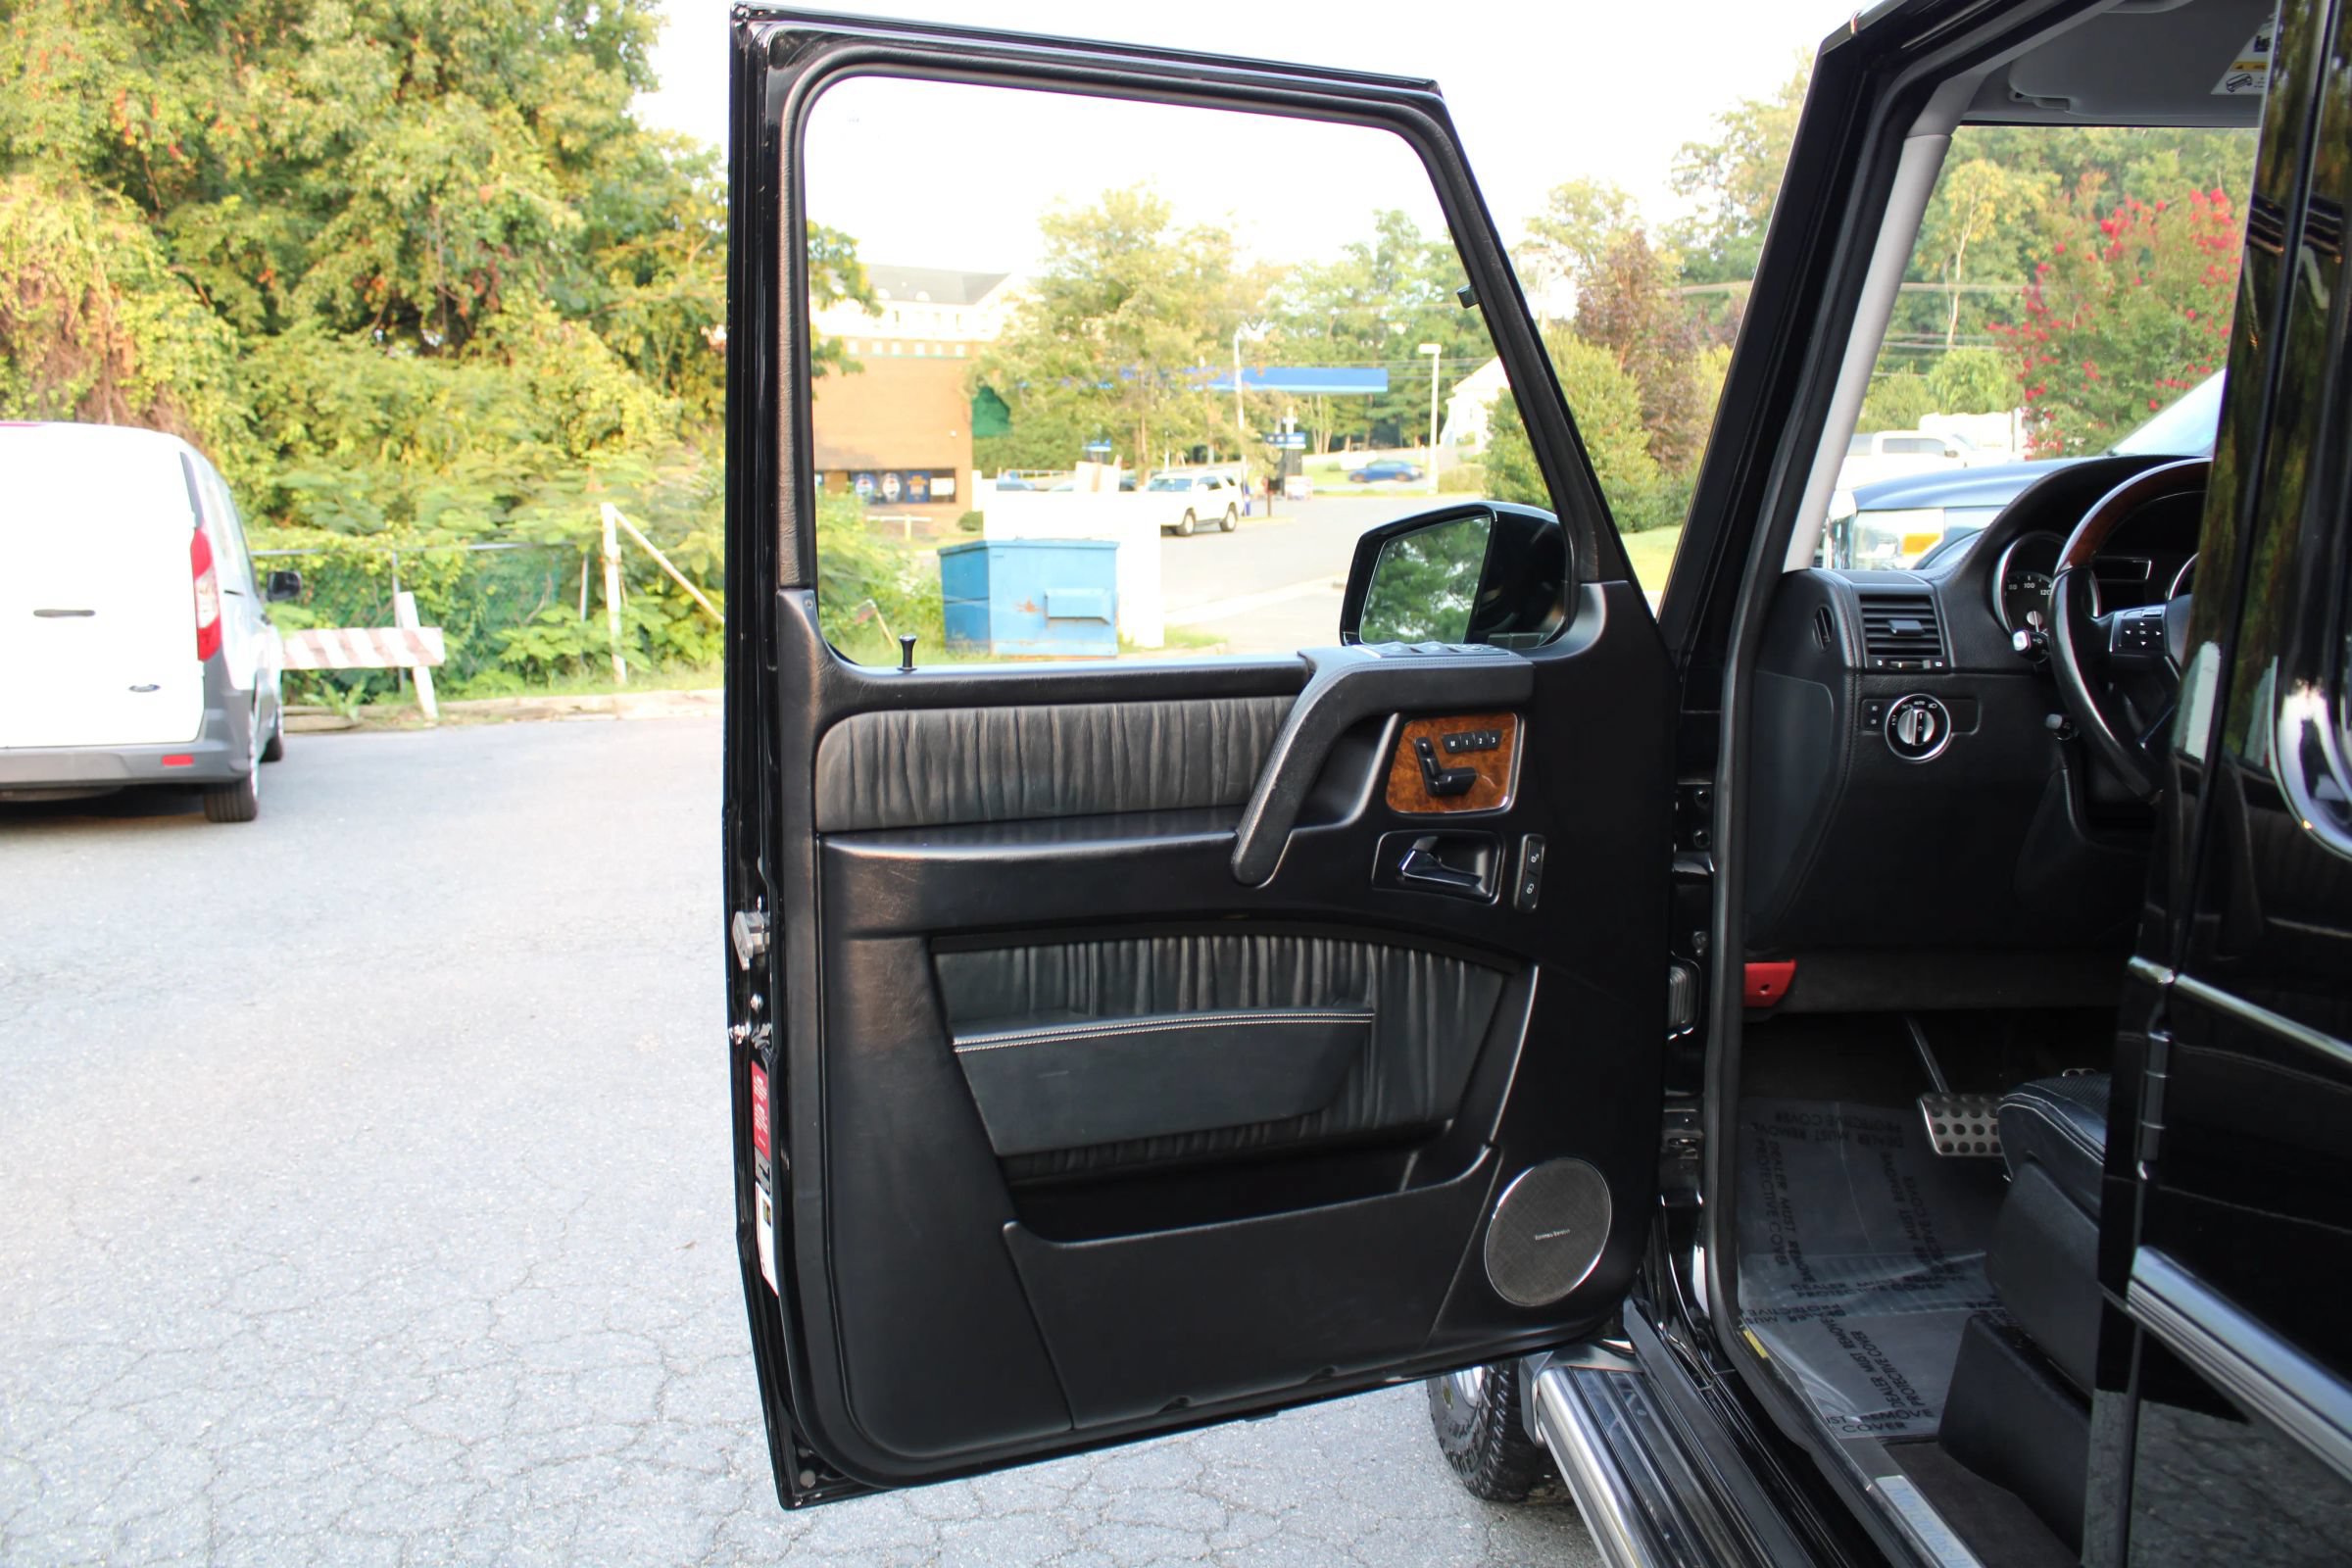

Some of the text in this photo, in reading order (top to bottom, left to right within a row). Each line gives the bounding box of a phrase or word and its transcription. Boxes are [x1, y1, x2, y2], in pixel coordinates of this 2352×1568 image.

[1775, 1110, 1823, 1126] COVER
[1814, 1129, 1849, 1142] MUST
[1755, 1138, 1789, 1266] PROTECTIVE COVER
[1768, 1140, 1788, 1191] DEALER
[1780, 1197, 1796, 1232] MUST
[1880, 1152, 1922, 1240] MUST REMOVE
[1903, 1175, 1928, 1217] COVER
[1820, 1316, 1906, 1408] DEALER MUST REMOVE
[1850, 1330, 1926, 1406] PROTECTIVE COVER
[1841, 1421, 1907, 1433] COVER
[1859, 1408, 1936, 1421] REMOVE
